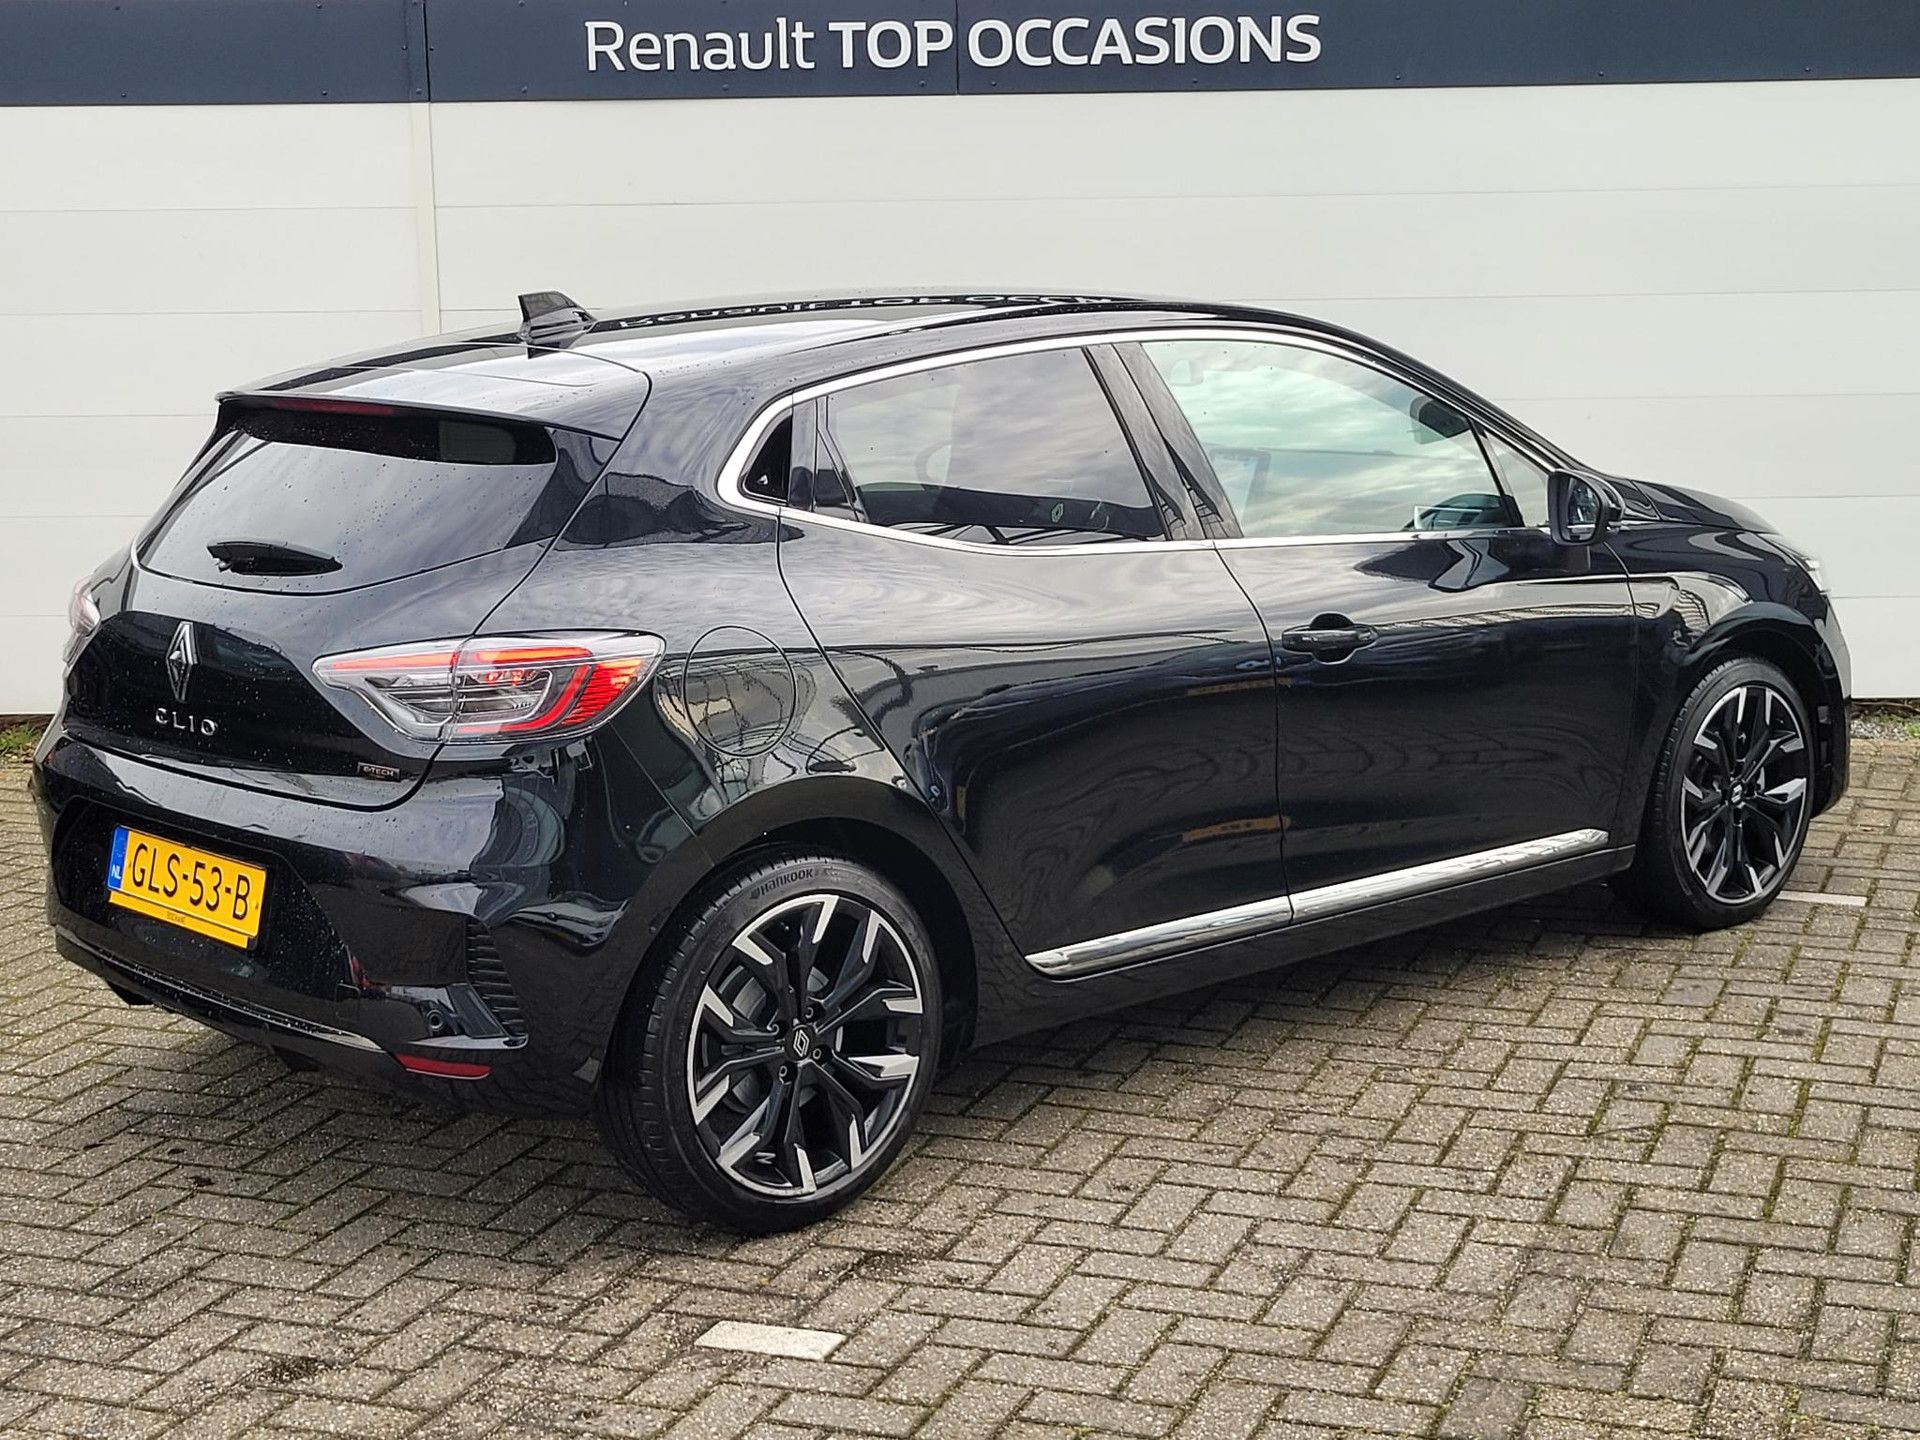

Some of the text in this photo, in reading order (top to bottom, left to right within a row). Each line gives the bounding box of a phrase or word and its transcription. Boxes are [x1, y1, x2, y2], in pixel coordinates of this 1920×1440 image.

[584, 14, 1321, 71] Renault TOP OCCASIONS
[155, 707, 216, 736] CLIO
[111, 865, 122, 880] NL
[132, 843, 250, 920] GLS-53-B
